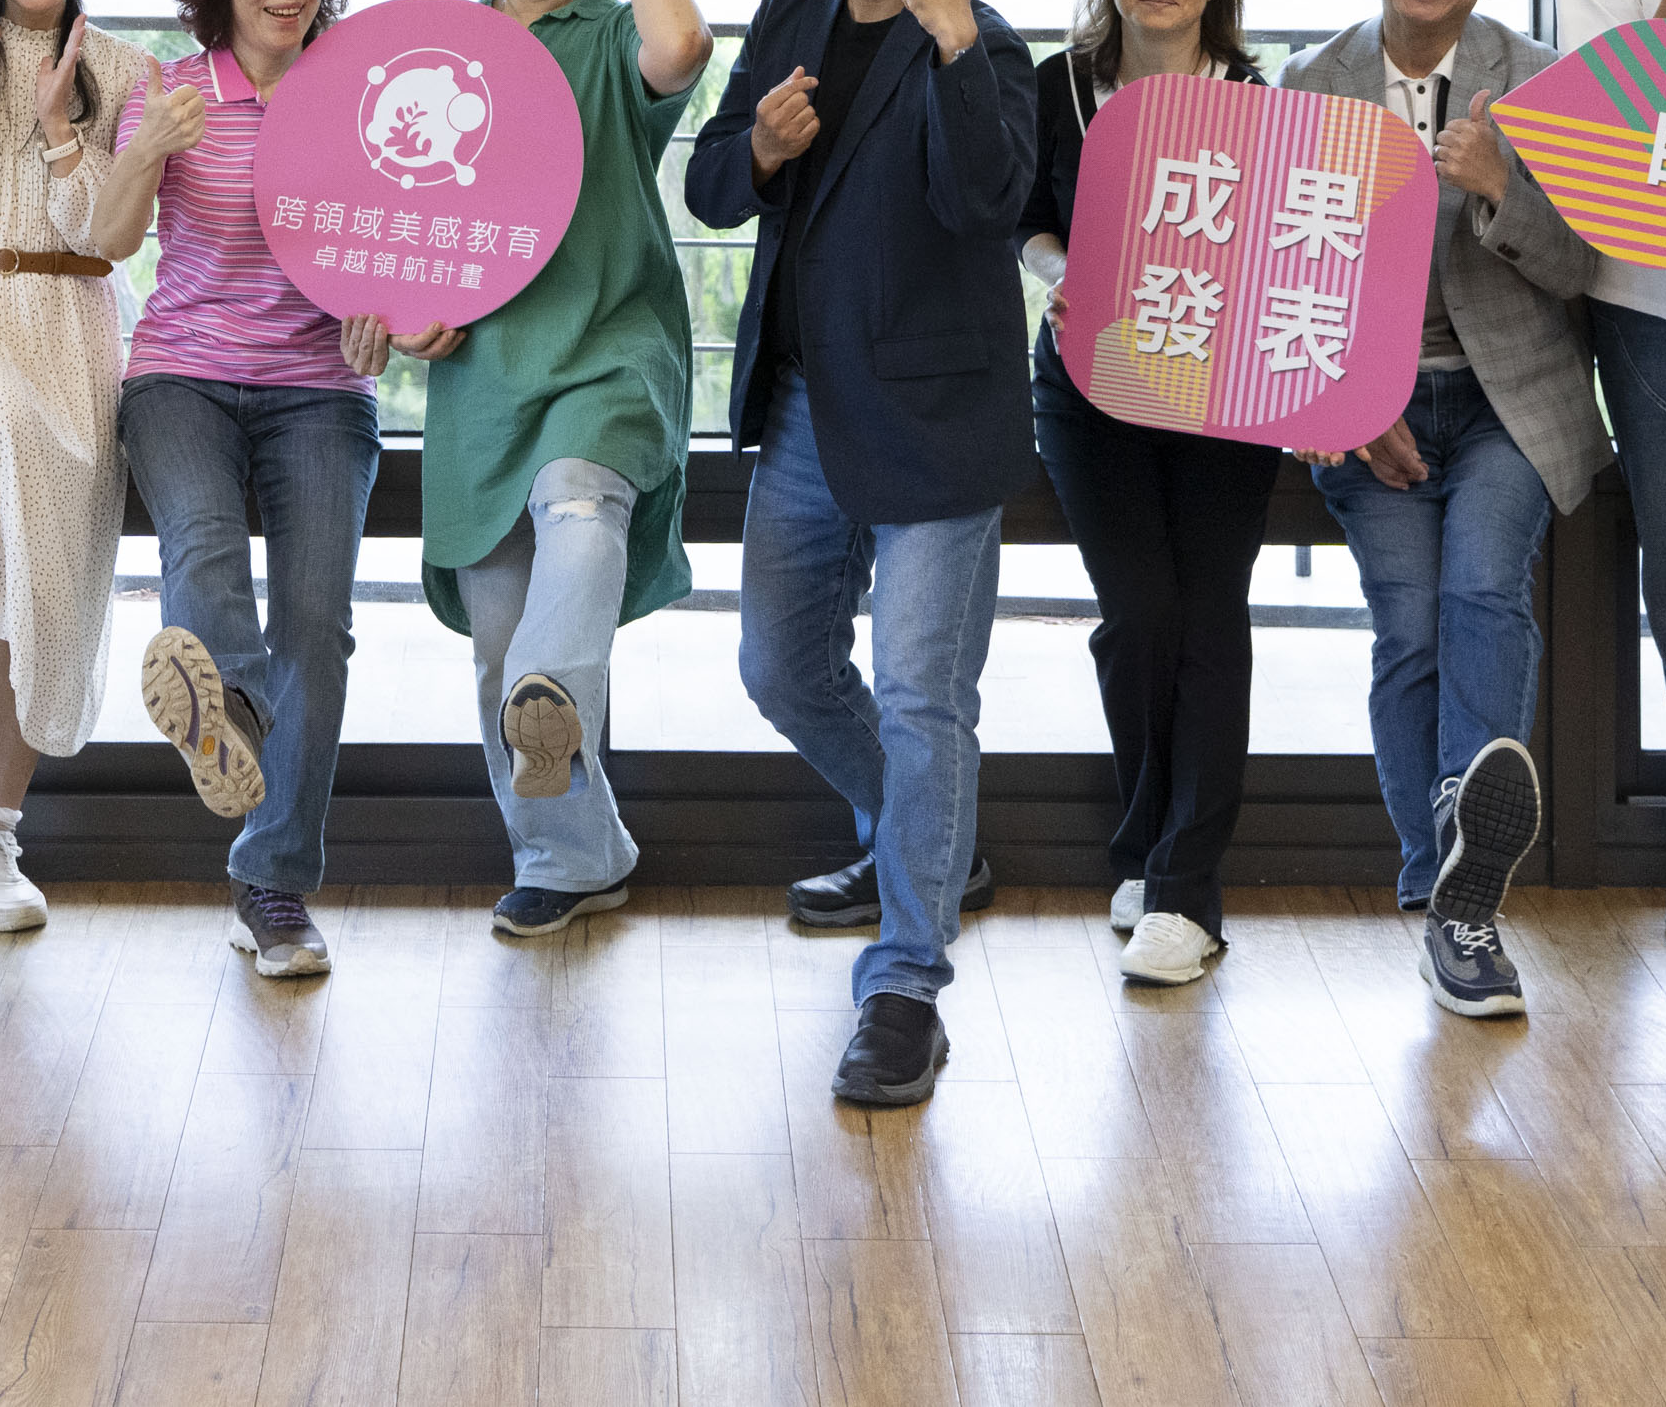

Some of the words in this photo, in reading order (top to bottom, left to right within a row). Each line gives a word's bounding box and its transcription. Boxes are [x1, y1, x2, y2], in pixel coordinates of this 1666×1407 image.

[270, 195, 541, 259] 跨領域美感教育
[1140, 148, 1364, 262] 成果
[311, 244, 486, 290] 卓越領航計畫
[1131, 262, 1351, 382] 發表
